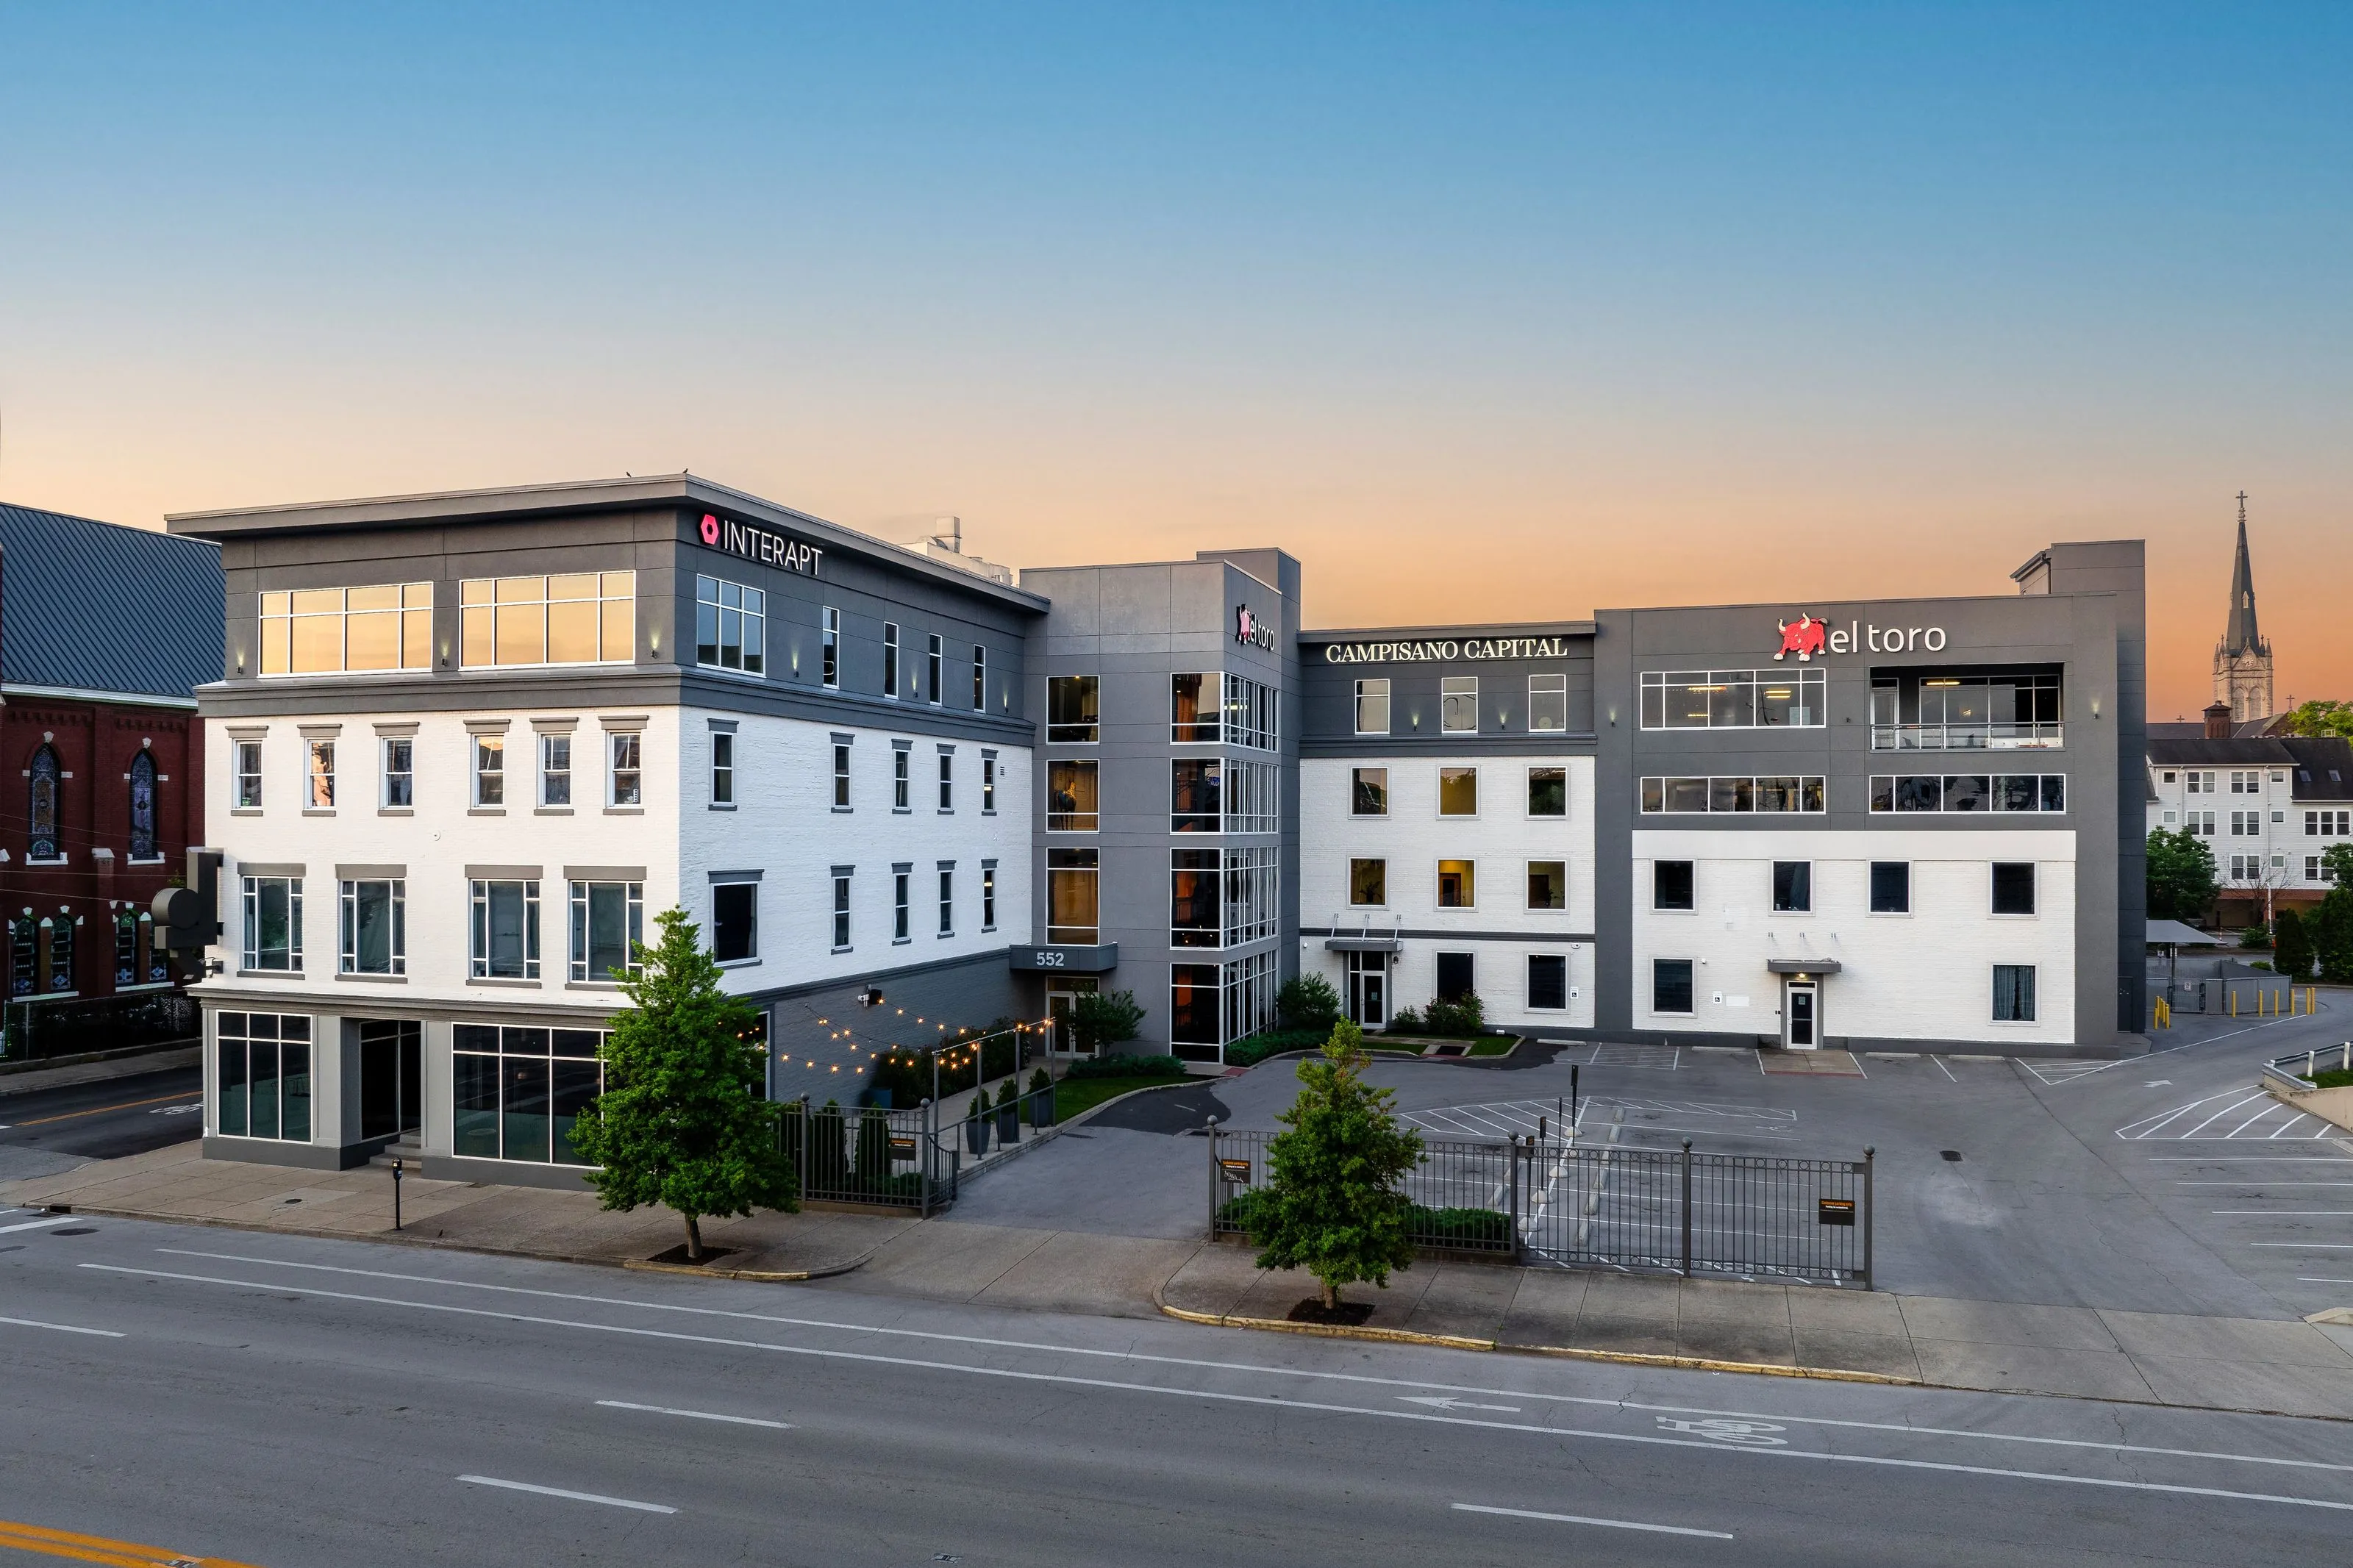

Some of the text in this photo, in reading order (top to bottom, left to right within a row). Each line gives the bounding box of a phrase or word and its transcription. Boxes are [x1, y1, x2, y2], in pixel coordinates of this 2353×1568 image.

[724, 520, 823, 576] INTERAPT
[1250, 614, 1275, 651] el toro
[1829, 620, 1946, 654] el toro
[1326, 638, 1568, 662] CAMPISANO CAPITAL
[1036, 952, 1064, 967] 552
